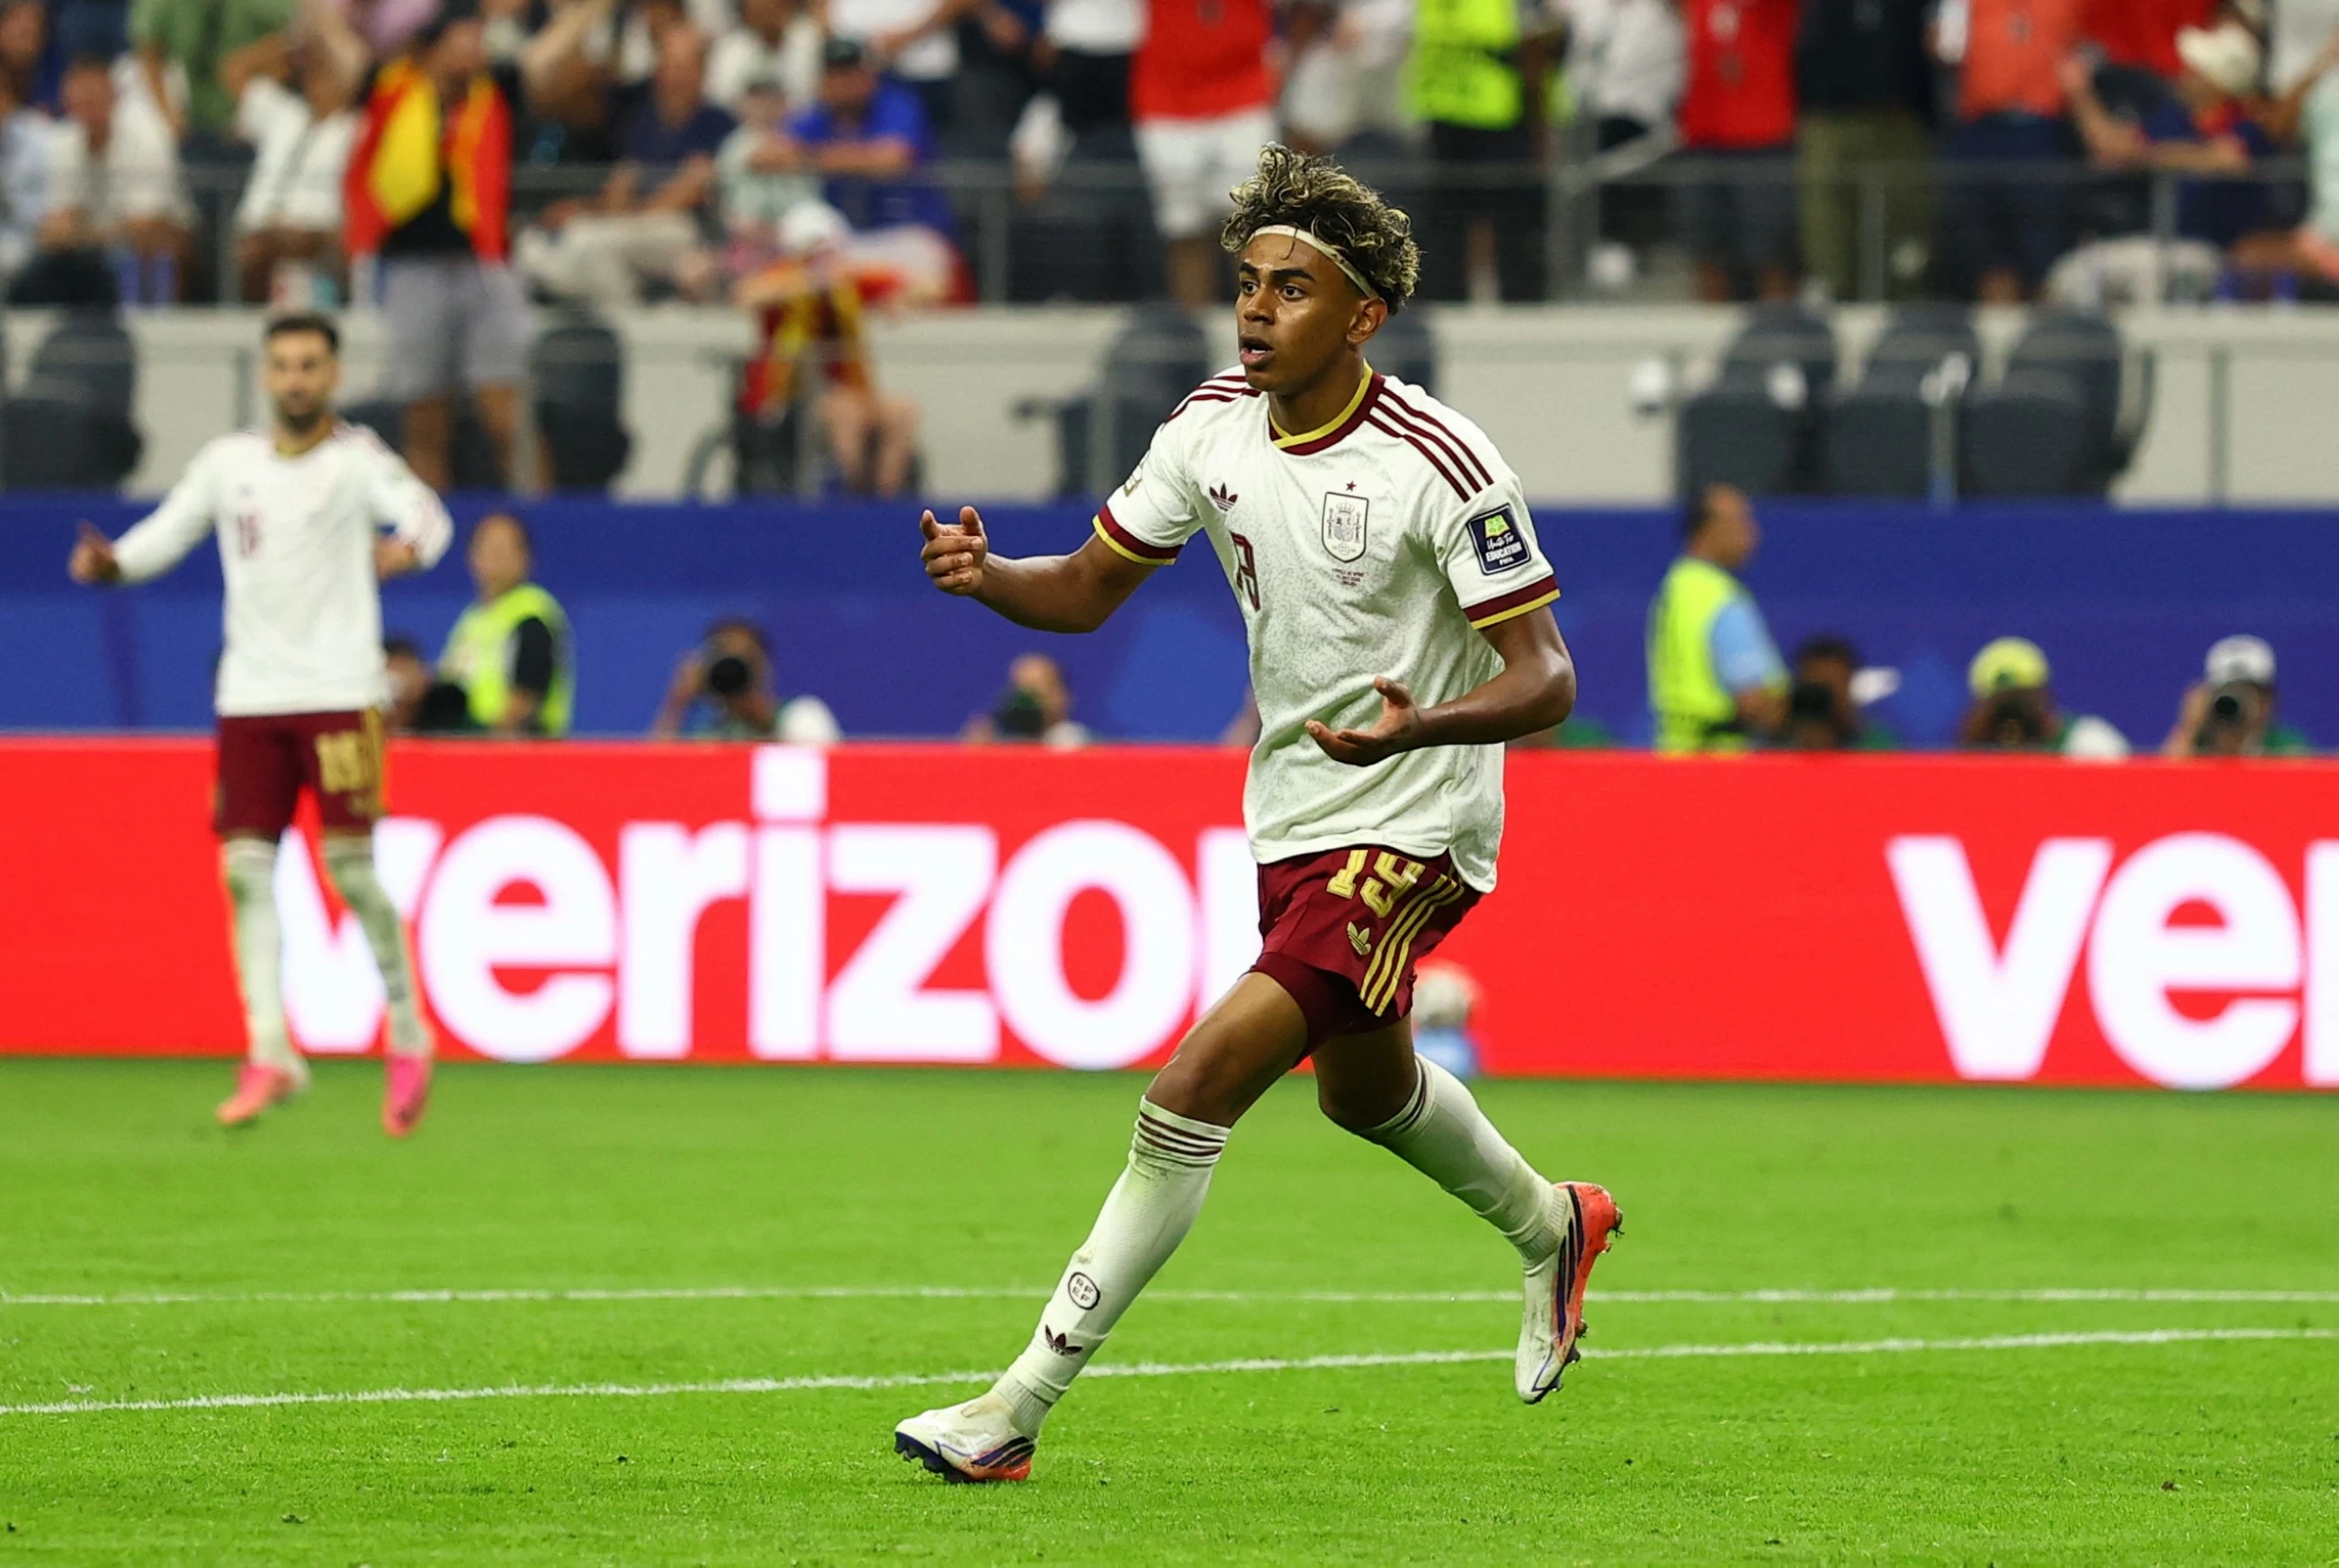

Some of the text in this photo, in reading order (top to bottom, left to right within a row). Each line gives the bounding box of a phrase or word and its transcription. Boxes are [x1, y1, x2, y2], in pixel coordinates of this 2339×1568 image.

[1485, 541, 1523, 562] EDUCATION
[1326, 849, 1426, 918] 19
[1886, 829, 2339, 1090] ve
